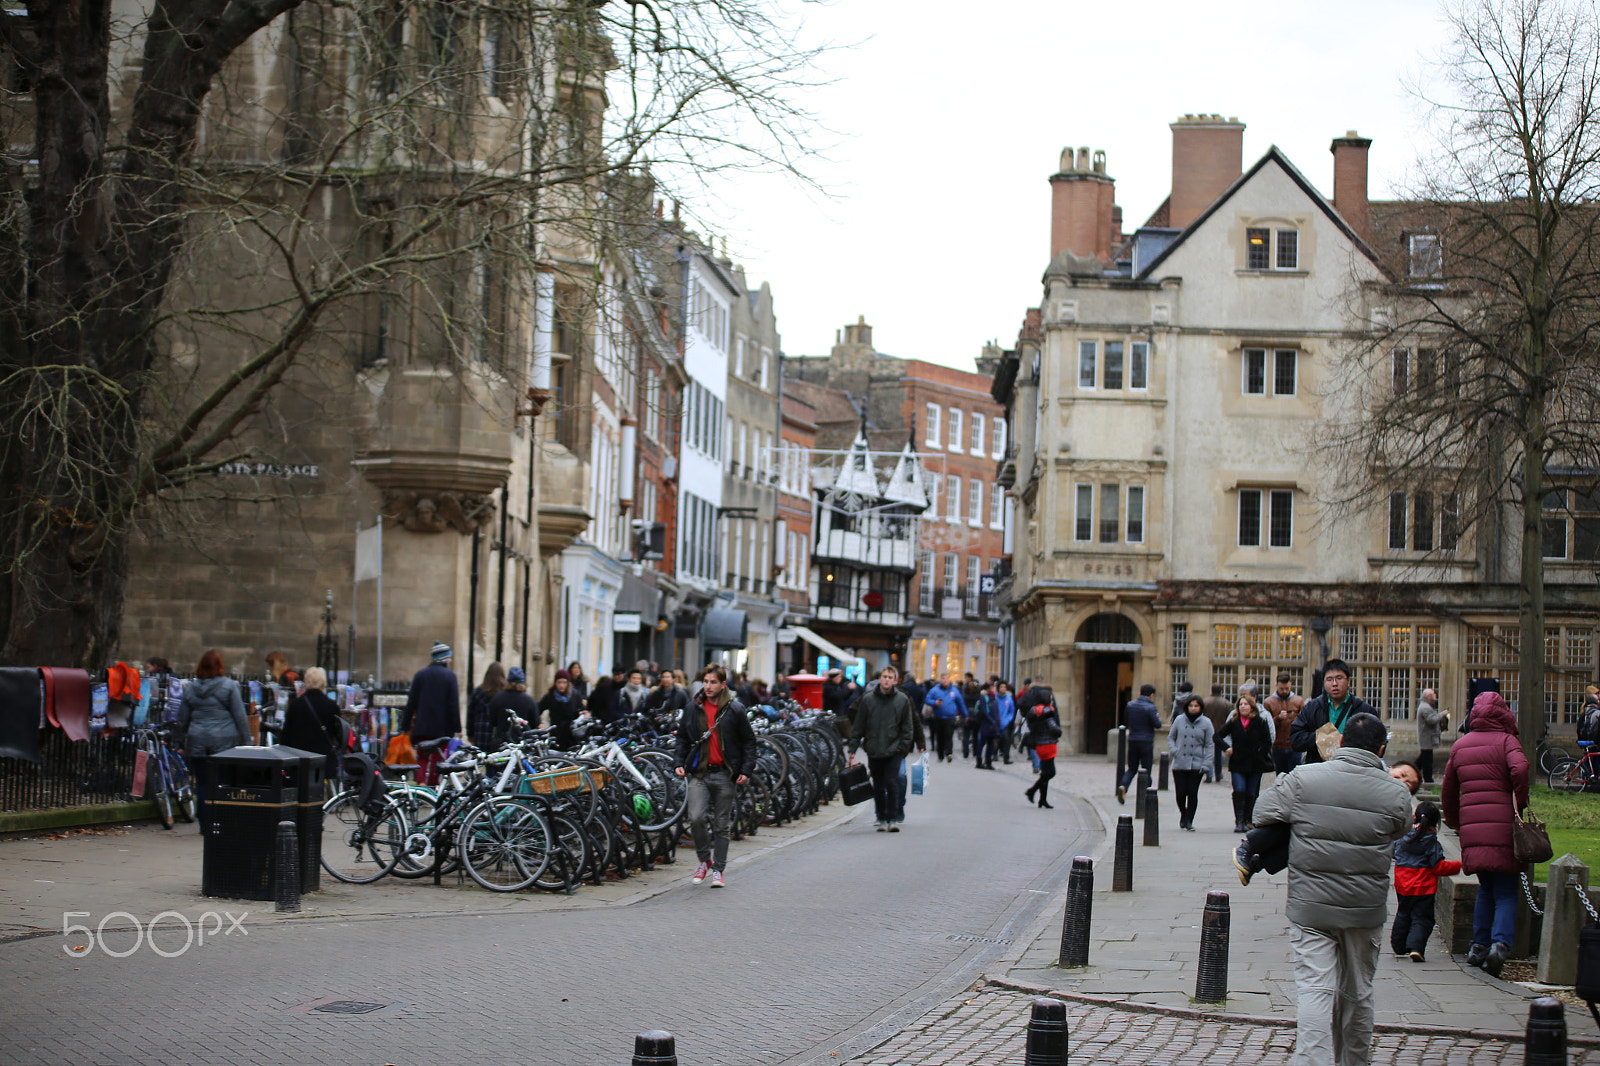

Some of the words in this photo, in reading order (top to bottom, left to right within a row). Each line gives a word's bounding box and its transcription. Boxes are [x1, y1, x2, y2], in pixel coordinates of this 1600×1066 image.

[256, 463, 319, 477] PASSAGE
[1083, 563, 1133, 576] REISS
[230, 791, 256, 801] Litter
